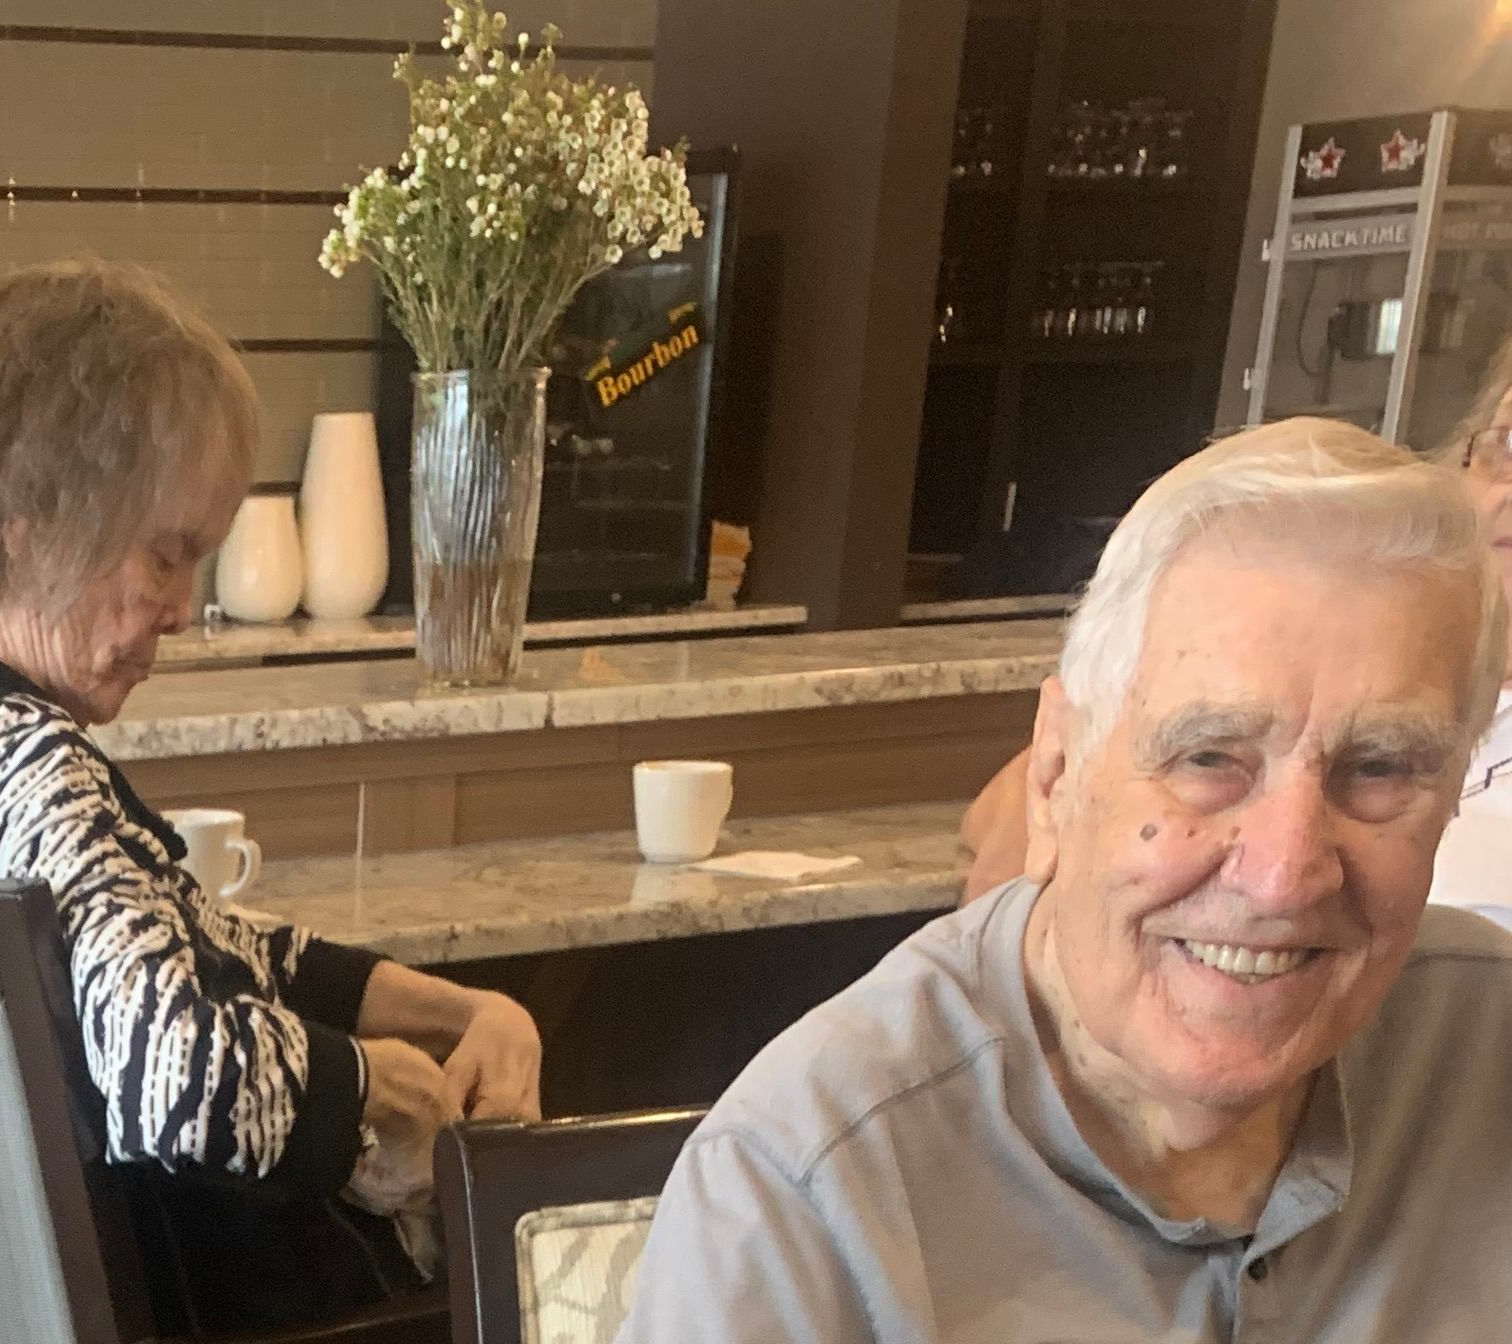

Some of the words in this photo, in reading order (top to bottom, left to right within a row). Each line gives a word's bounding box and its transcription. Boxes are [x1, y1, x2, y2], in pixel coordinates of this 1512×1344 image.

[1291, 229, 1358, 250] SNACK
[1362, 223, 1408, 245] TIME
[597, 325, 699, 407] Bourbon
